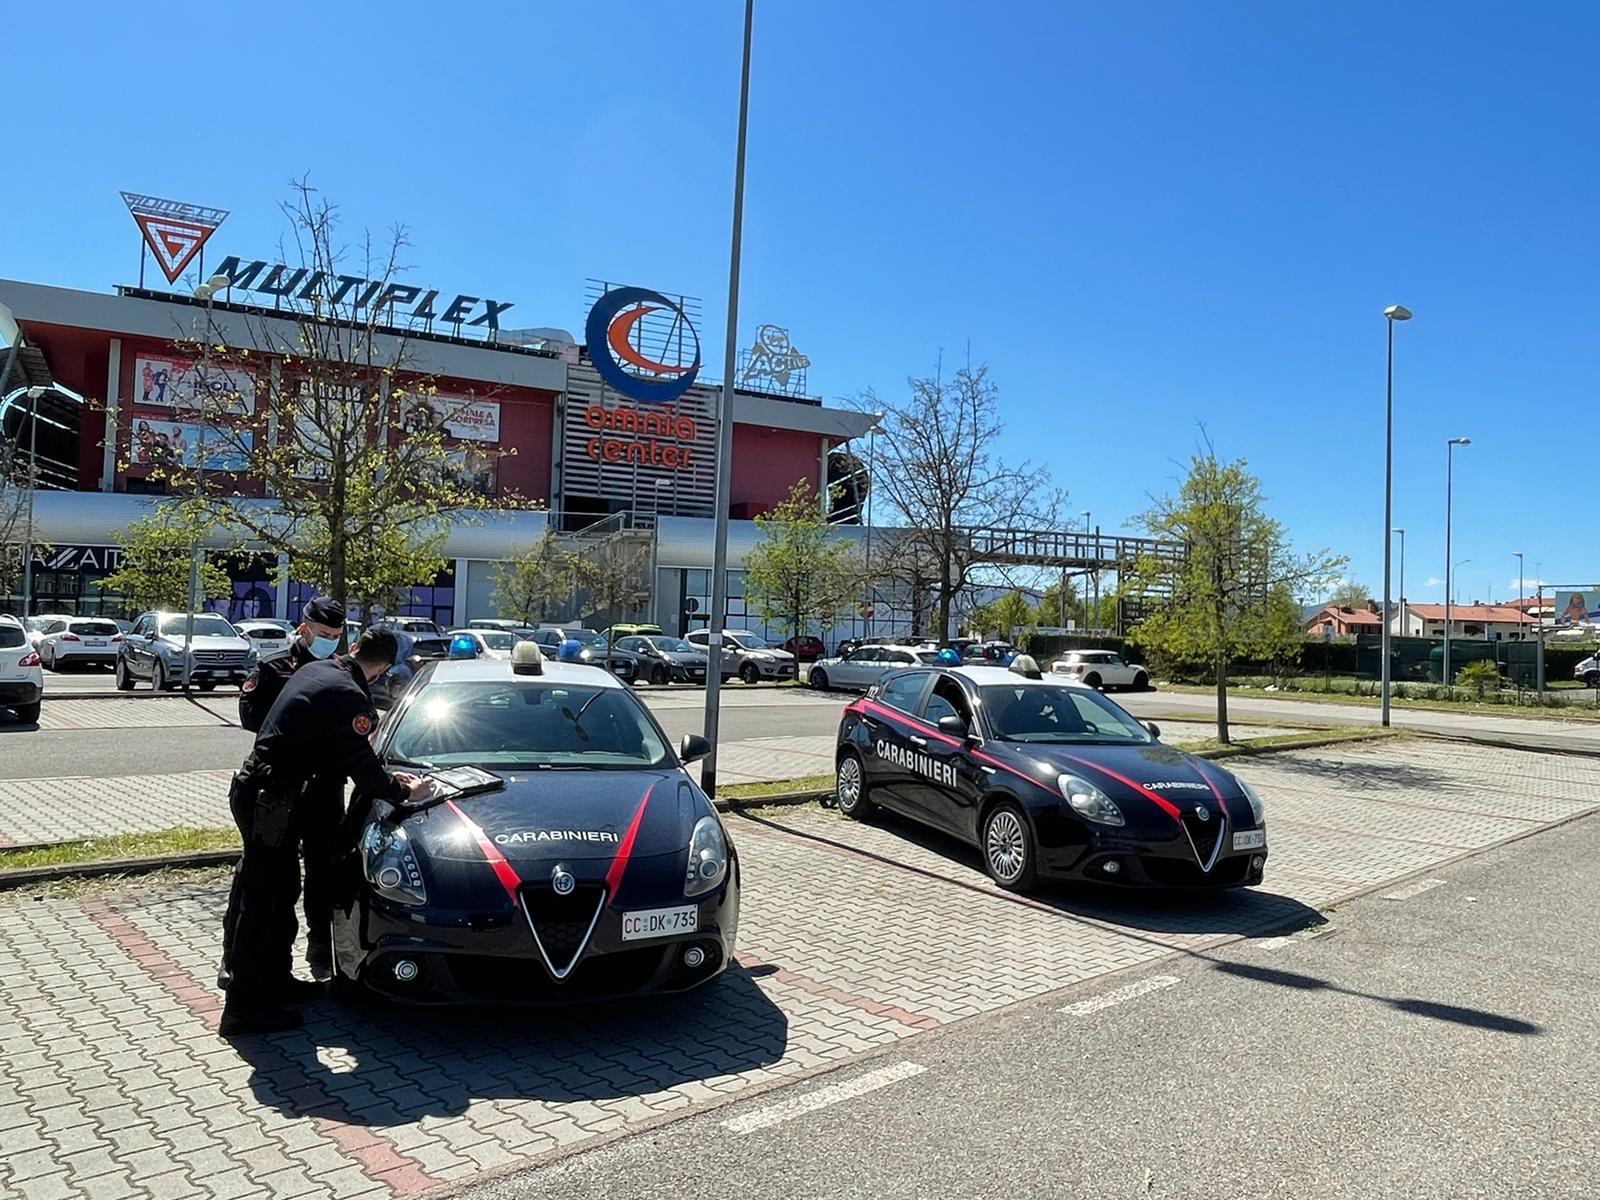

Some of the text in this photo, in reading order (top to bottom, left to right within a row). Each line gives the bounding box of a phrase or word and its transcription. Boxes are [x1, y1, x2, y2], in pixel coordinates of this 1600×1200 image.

[211, 256, 514, 331] MULTIPLEX
[585, 405, 697, 439] omnia
[587, 438, 692, 468] center
[876, 739, 957, 788] CARABINIERI
[494, 831, 619, 844] CARABINIERI
[624, 911, 696, 934] CC DK 735
